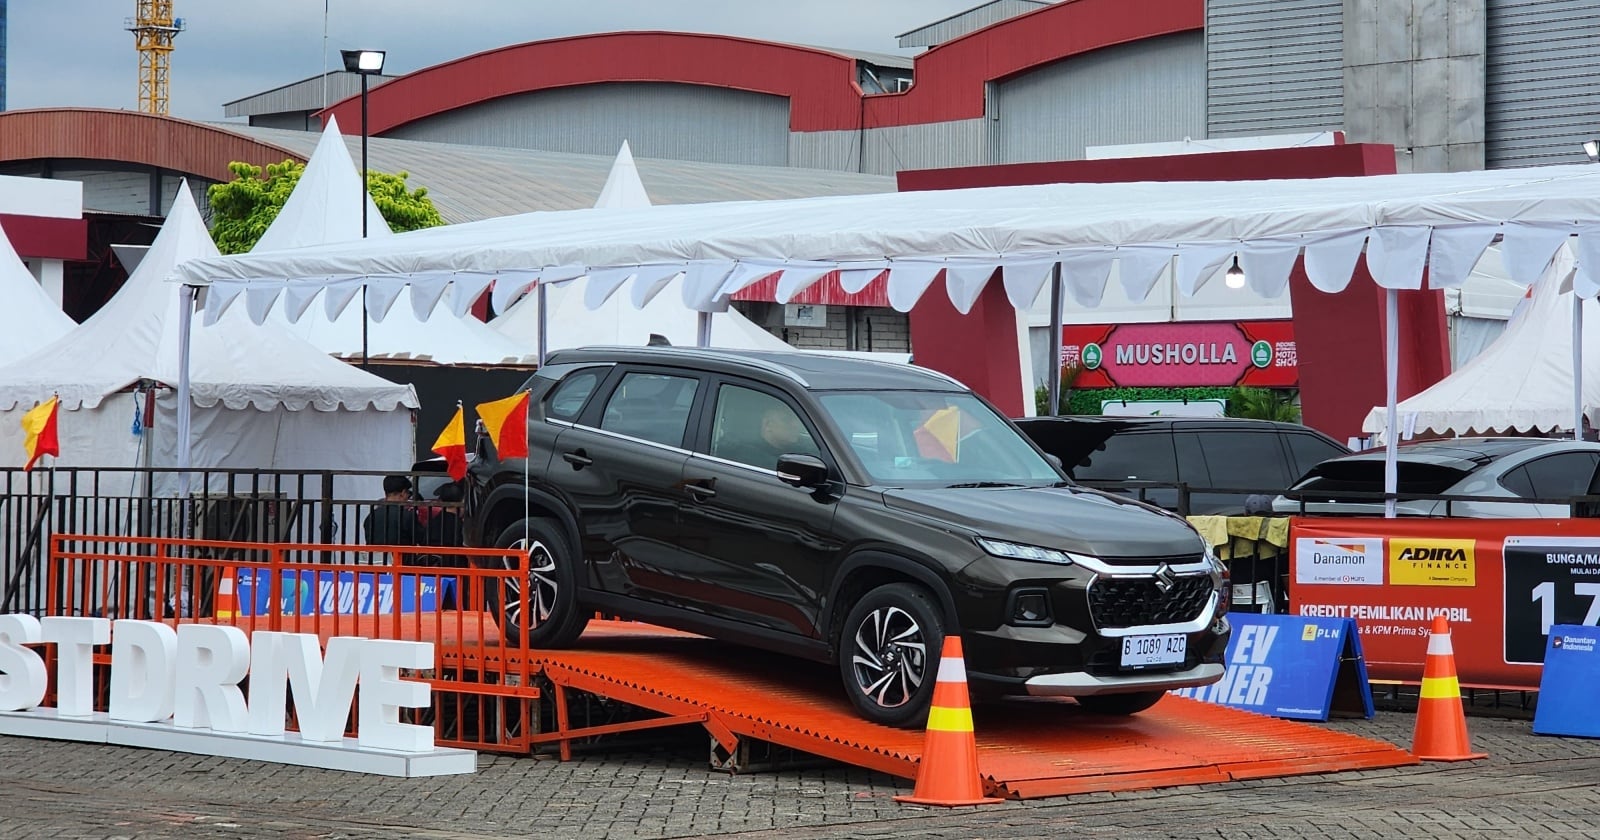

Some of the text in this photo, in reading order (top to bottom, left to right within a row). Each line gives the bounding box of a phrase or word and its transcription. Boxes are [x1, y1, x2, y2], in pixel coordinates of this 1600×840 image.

[1116, 343, 1238, 365] MUSHOLLA
[1313, 552, 1365, 565] Danamon
[1398, 548, 1467, 561] ADIRA
[1300, 605, 1472, 623] KREDIT PEMILIKAN MOBIL
[1317, 628, 1340, 639] PLN
[1364, 626, 1371, 634] &
[1372, 626, 1391, 635] KPM
[1392, 626, 1416, 636] Prima
[1124, 637, 1185, 655] B 1089 AZC
[1231, 625, 1280, 664] EV
